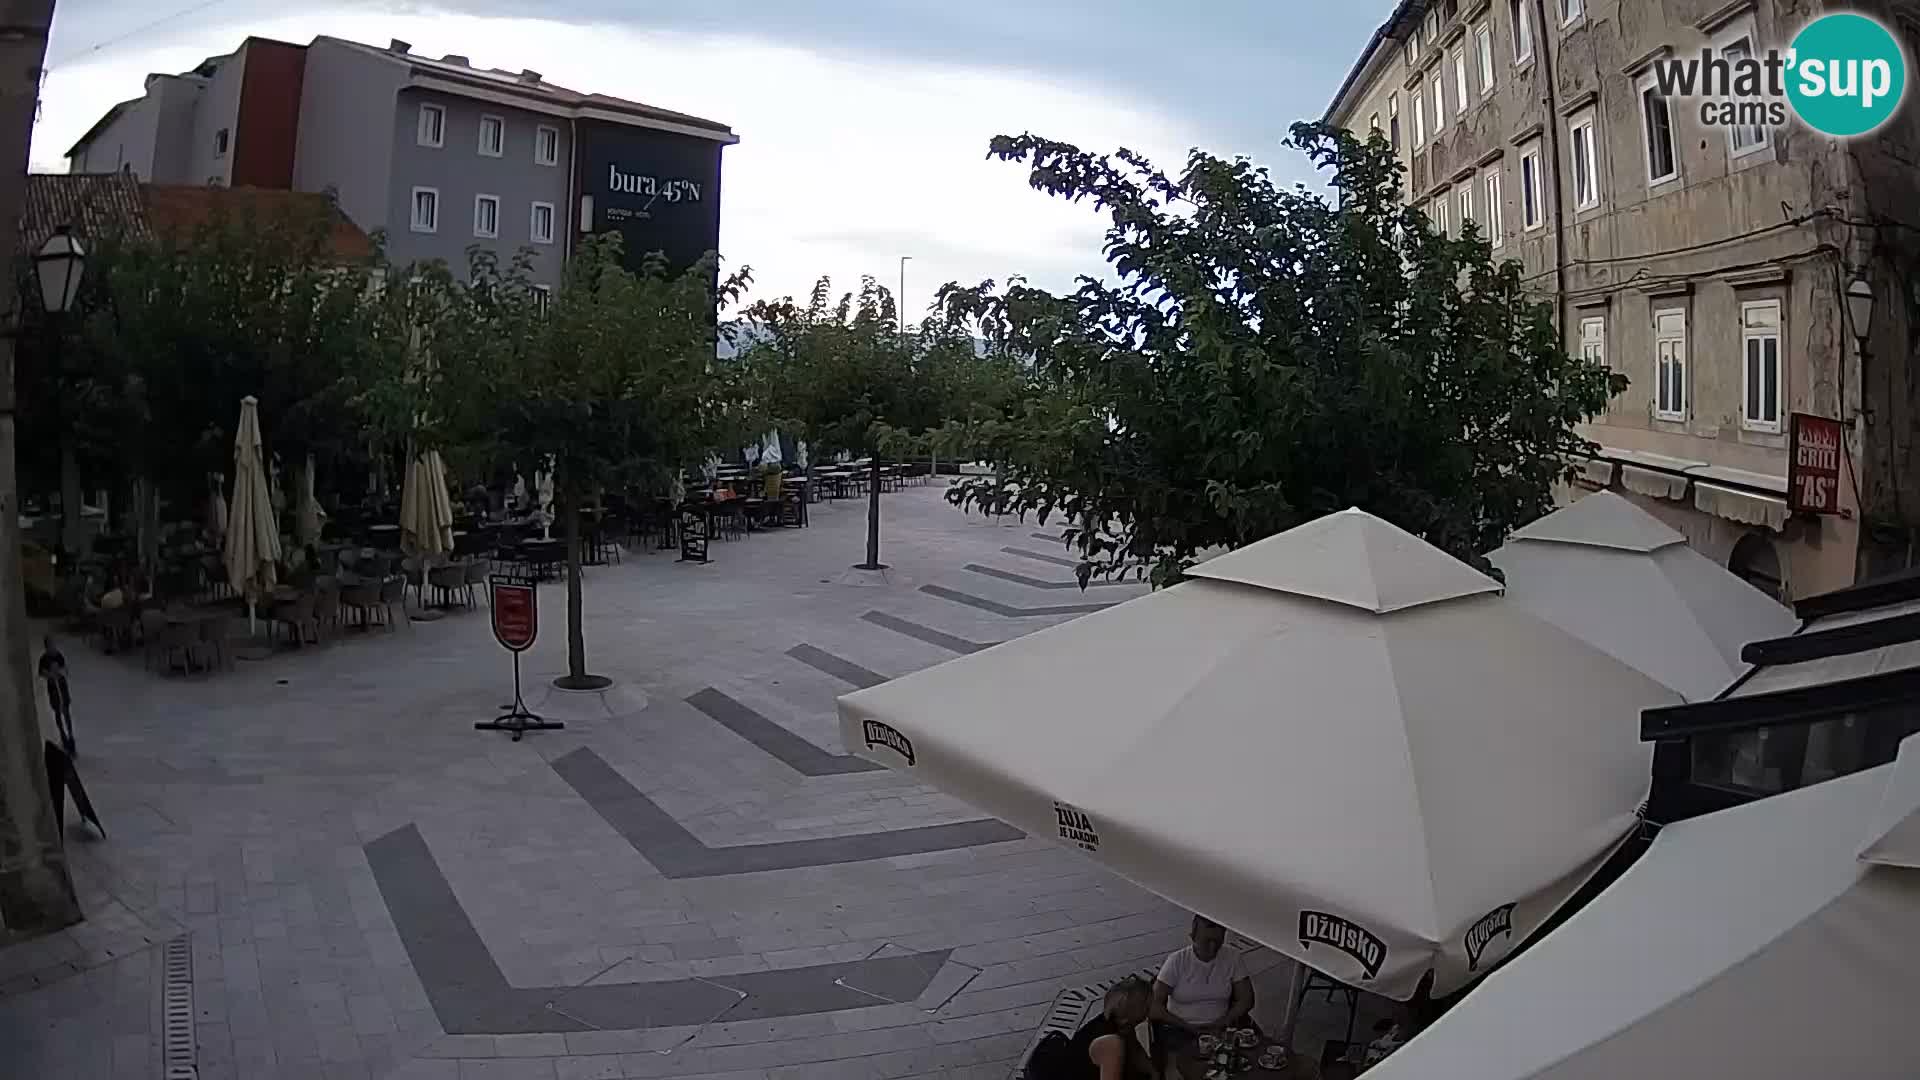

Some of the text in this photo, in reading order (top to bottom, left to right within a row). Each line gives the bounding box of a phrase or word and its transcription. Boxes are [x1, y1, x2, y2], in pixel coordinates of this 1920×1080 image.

[609, 164, 656, 195] bura
[1797, 446, 1838, 471] GRILL
[1306, 914, 1380, 967] Ožujsko
